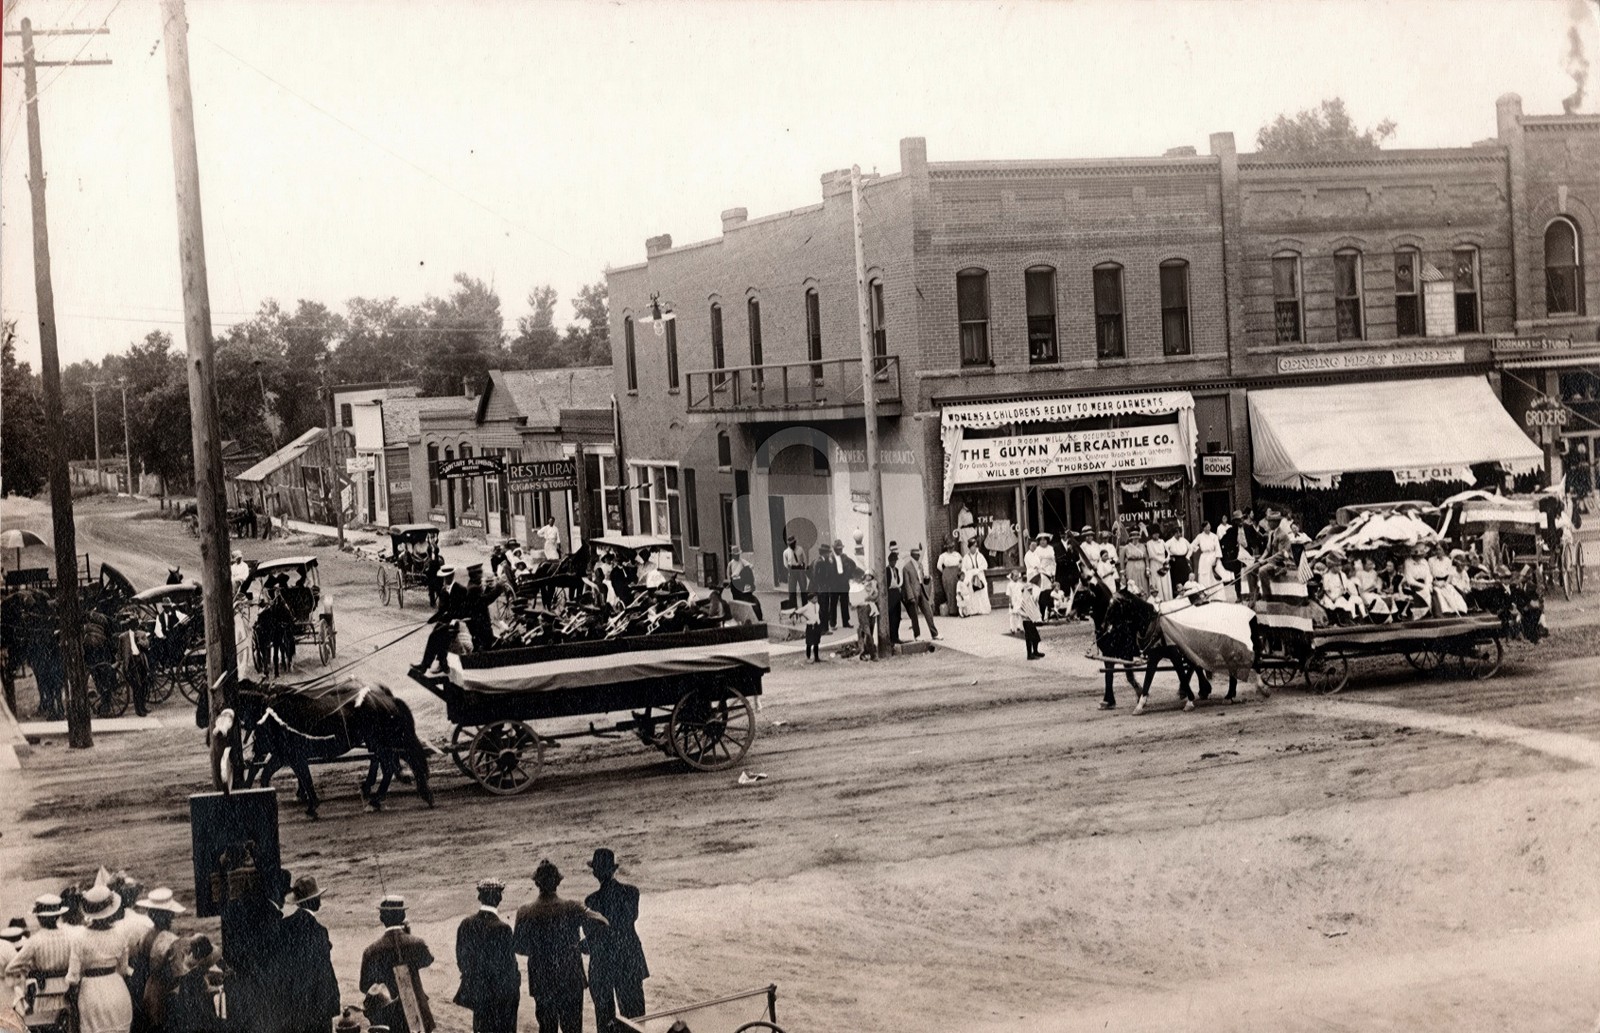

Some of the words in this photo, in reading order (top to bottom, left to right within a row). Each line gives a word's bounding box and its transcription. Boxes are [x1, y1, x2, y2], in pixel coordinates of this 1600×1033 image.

[1343, 353, 1387, 367] MEAT
[947, 411, 984, 422] WOMENS
[994, 406, 1041, 419] CHILDRENS
[1044, 403, 1072, 415] READY
[1077, 402, 1088, 412] TO
[1091, 401, 1114, 411] WEAR
[1117, 397, 1163, 409] GARMENTS
[1525, 409, 1567, 426] GROCERS
[993, 439, 1012, 447] THIS
[1018, 437, 1039, 445] ROOM
[1045, 434, 1063, 443] WILL
[1120, 429, 1130, 437] BY
[961, 448, 990, 461] THE
[999, 444, 1048, 458] GUYNN
[1060, 436, 1149, 454] MERCANTILE
[1154, 434, 1175, 446] CO.
[510, 462, 577, 478] RESTAURAN
[986, 469, 1007, 478] WILL
[1010, 468, 1020, 476] BE
[1023, 466, 1047, 476] OPEN
[1057, 461, 1107, 473] THURSDAY
[1112, 458, 1136, 468] JUNE
[1204, 464, 1232, 473] ROOMS
[511, 482, 541, 492] CIGARS
[549, 479, 578, 489] TOBACC
[978, 515, 994, 523] THE
[1120, 511, 1150, 522] GUYNN
